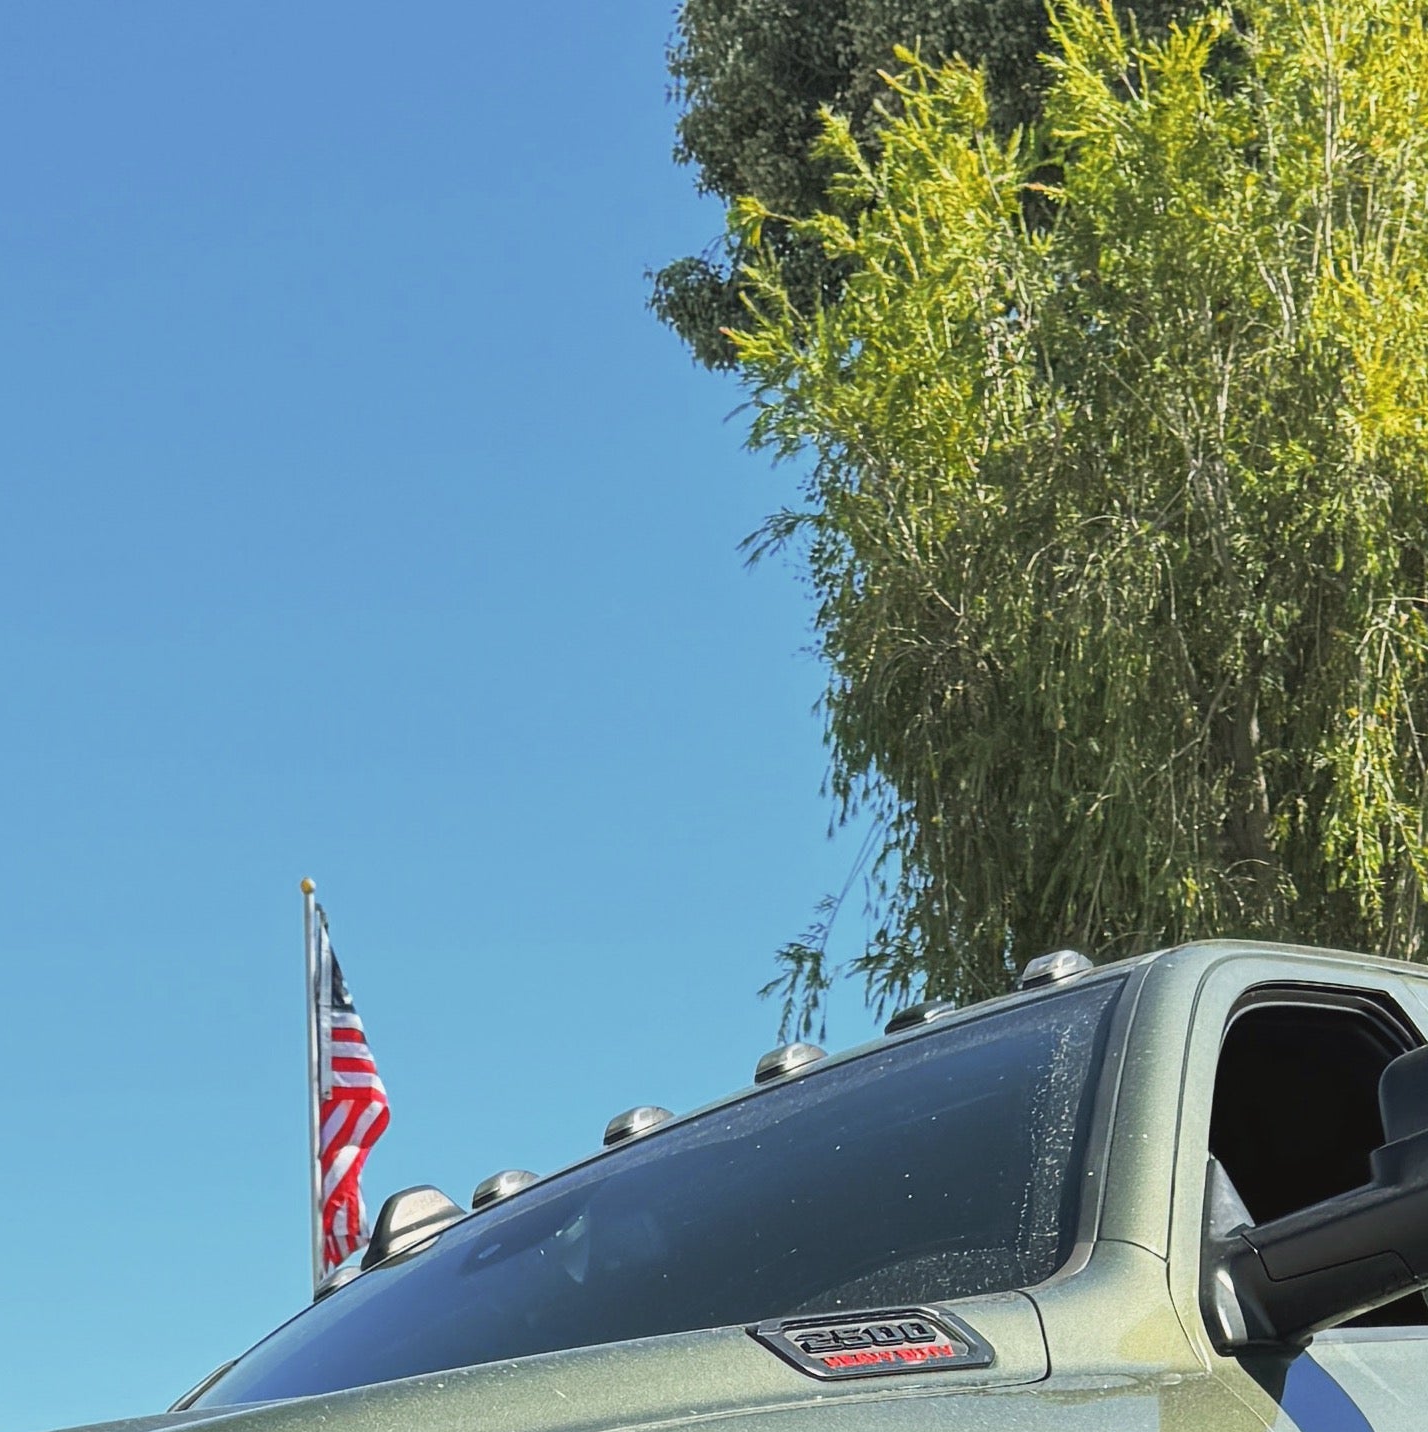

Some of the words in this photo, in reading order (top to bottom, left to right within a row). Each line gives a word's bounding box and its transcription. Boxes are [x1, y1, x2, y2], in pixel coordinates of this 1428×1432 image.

[793, 1319, 937, 1354] 2500
[822, 1350, 895, 1369] HEAVY
[894, 1344, 954, 1363] DUTY
